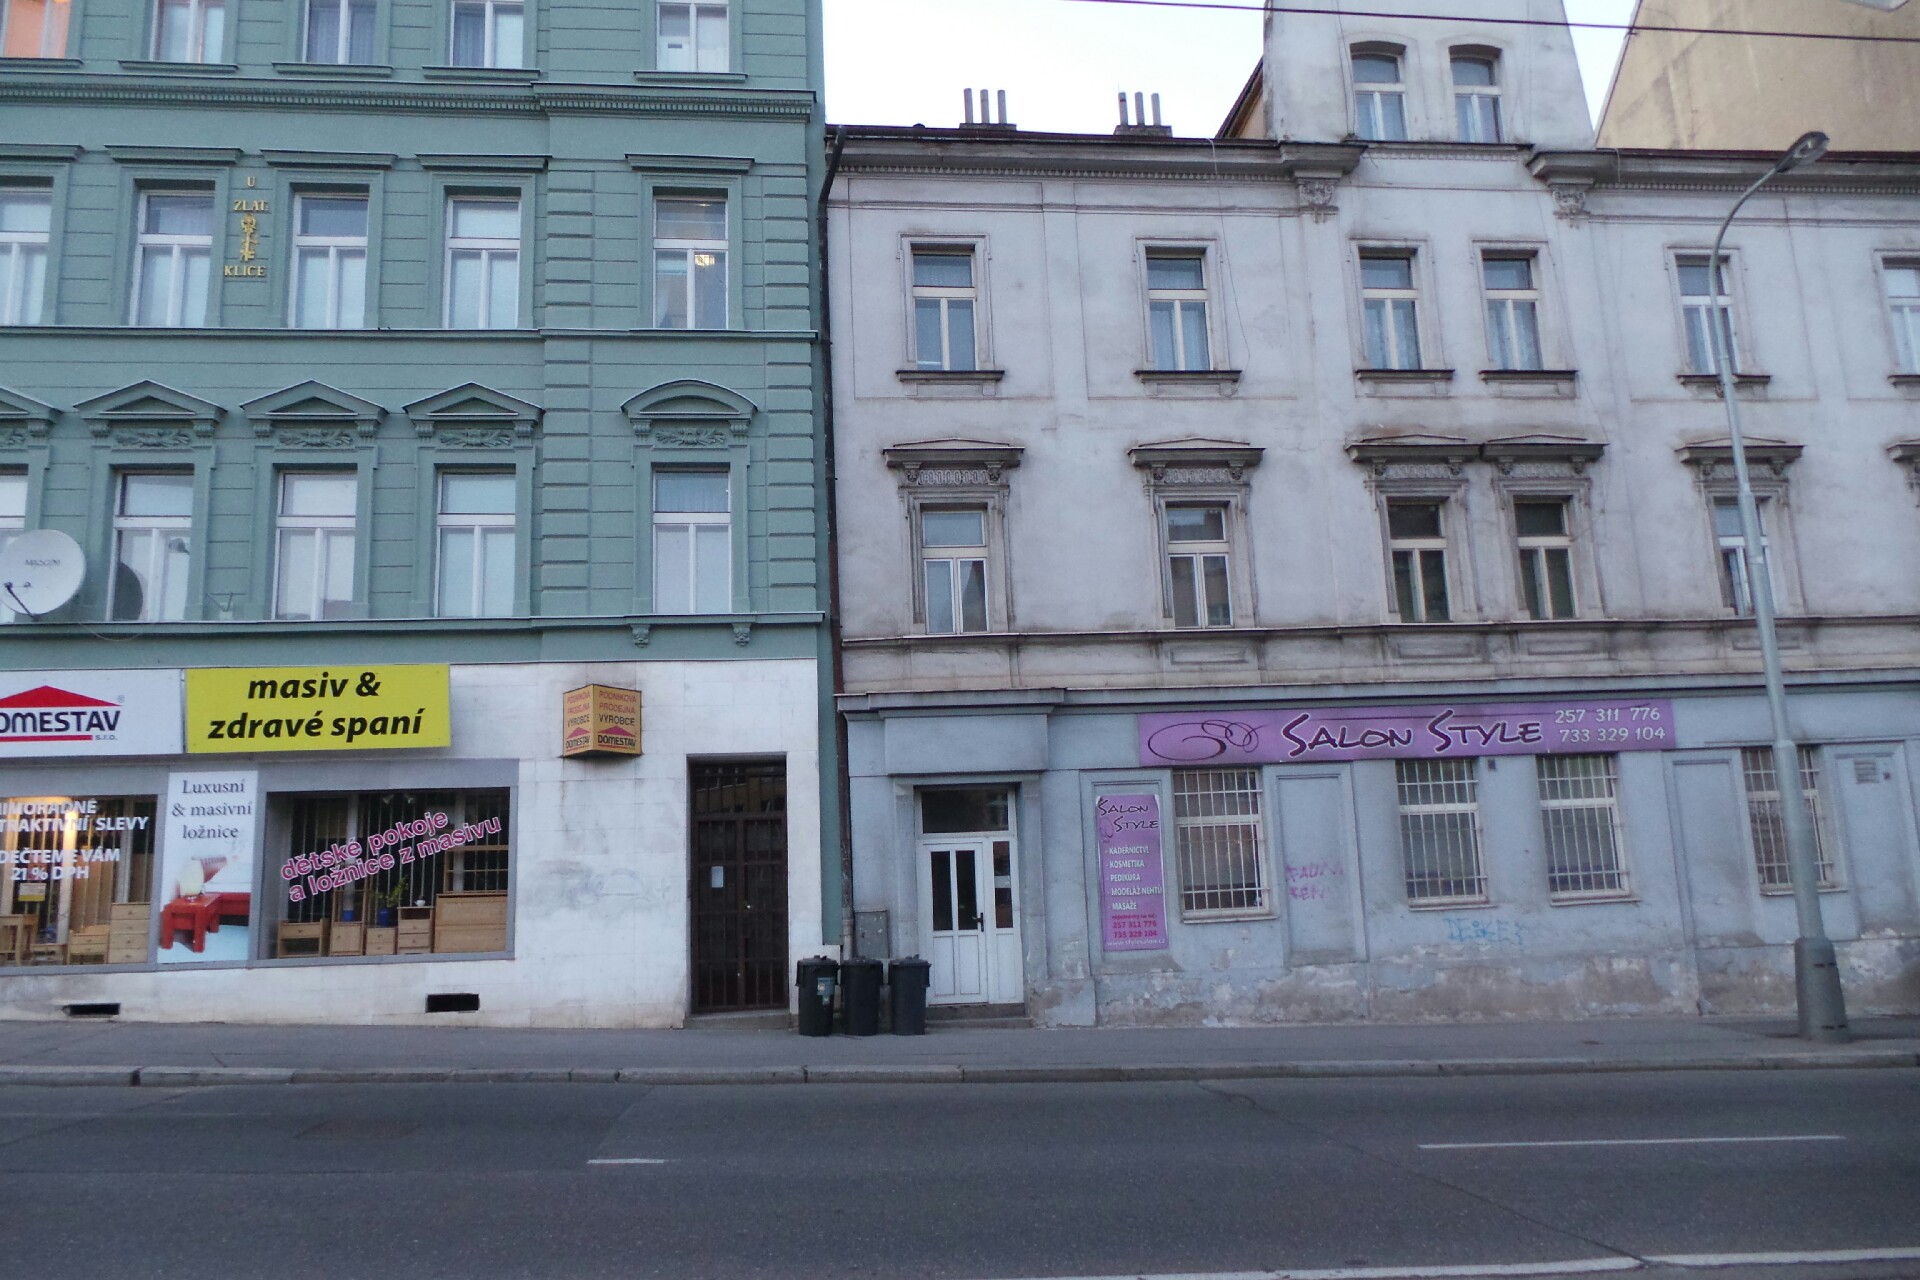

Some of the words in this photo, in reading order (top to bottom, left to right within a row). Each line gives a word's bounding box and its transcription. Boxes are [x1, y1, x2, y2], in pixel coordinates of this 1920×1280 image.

[247, 176, 256, 187] U
[248, 672, 348, 699] masiv
[355, 671, 381, 697] &
[1555, 710, 1586, 724] 257
[1596, 709, 1619, 722] 311
[1631, 707, 1660, 721] 776
[208, 711, 323, 739] zdravé
[331, 708, 425, 743] spaní
[1283, 713, 1412, 756] SALON
[1427, 709, 1542, 752] STYLE
[1560, 729, 1590, 743] 733
[1598, 728, 1629, 742] 329
[1636, 727, 1665, 740] 104
[182, 779, 245, 794] Luxusní
[172, 802, 185, 817] &
[190, 801, 252, 816] masivní
[1098, 798, 1149, 816] SALON
[95, 816, 149, 831] SLEVY
[1113, 816, 1158, 832] STYLE
[182, 825, 239, 839] ložnice
[80, 846, 120, 862] VÁM
[280, 837, 362, 880] dětské
[368, 812, 448, 856] pokoje
[289, 883, 306, 902] a
[308, 852, 395, 895] ložnice
[399, 846, 416, 864] z
[416, 816, 502, 858] masivu
[1109, 860, 1145, 869] KOSMETIKA
[11, 867, 28, 880] 21
[31, 867, 49, 880] %
[52, 866, 89, 880] DPH
